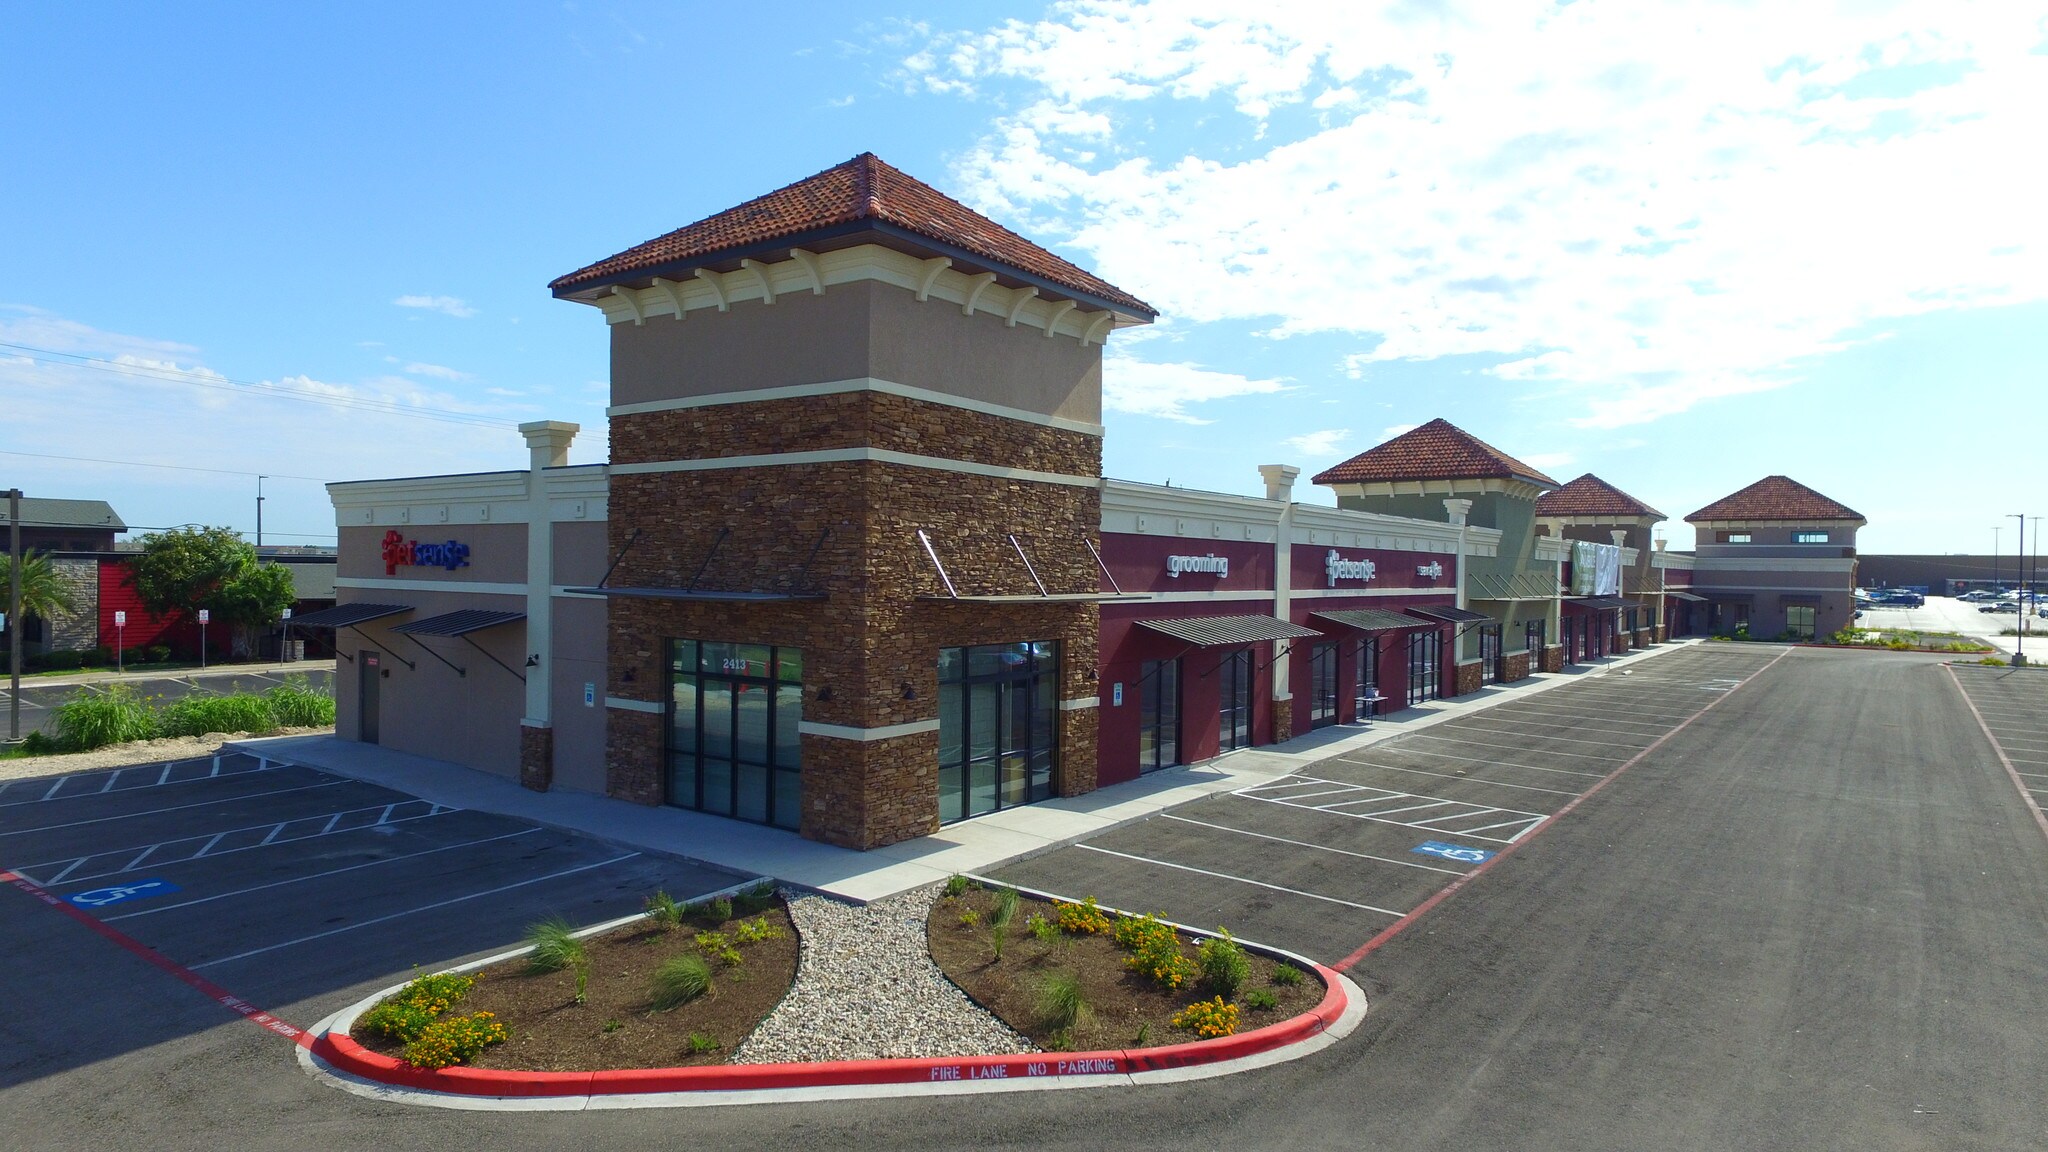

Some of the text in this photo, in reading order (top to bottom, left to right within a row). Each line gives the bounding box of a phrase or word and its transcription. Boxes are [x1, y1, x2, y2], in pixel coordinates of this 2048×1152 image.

[382, 530, 470, 575] petsense
[1167, 553, 1229, 578] grooming
[1325, 549, 1376, 587] petsense
[723, 658, 746, 669] 2413
[931, 1058, 1116, 1081] FIRE LANE NO PARKING
